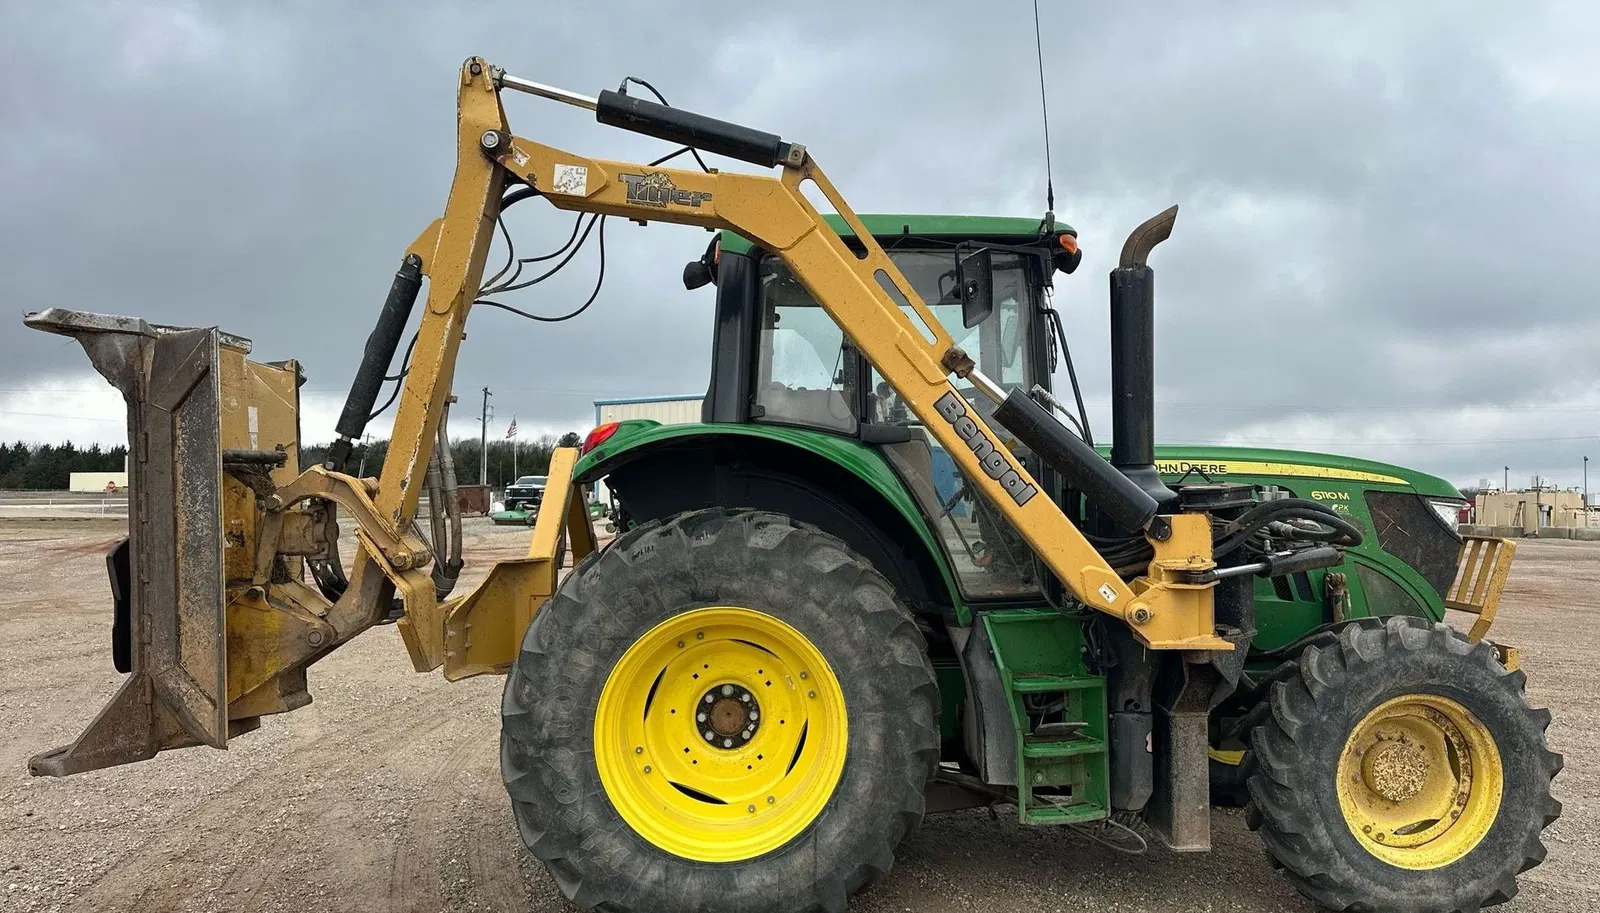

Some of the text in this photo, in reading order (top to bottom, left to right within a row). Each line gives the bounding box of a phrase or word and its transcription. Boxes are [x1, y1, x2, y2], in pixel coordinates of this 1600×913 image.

[617, 172, 713, 208] Tiger
[933, 390, 1039, 507] Bengal
[1311, 491, 1350, 500] 6110 M
